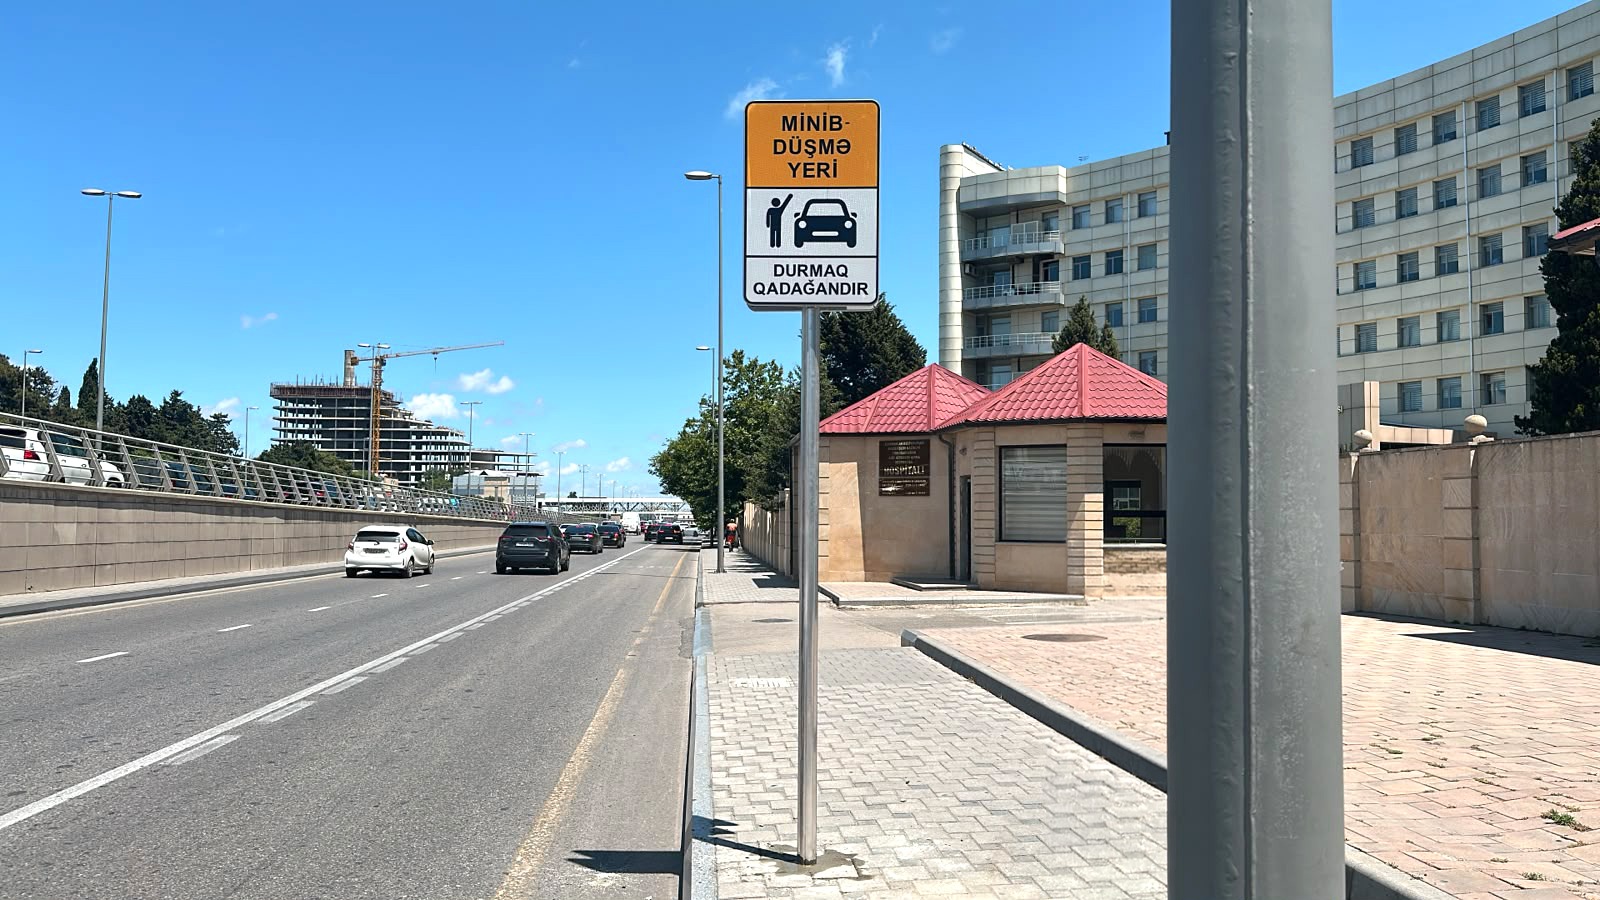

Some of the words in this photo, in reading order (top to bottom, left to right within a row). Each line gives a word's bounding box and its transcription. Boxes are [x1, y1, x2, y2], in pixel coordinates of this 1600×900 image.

[781, 112, 851, 132] MİNİB-
[773, 135, 851, 158] DÜŞMƏ
[787, 158, 838, 178] YERİ
[773, 263, 849, 278] DURMAQ
[753, 279, 869, 296] QADAĞANDIR
